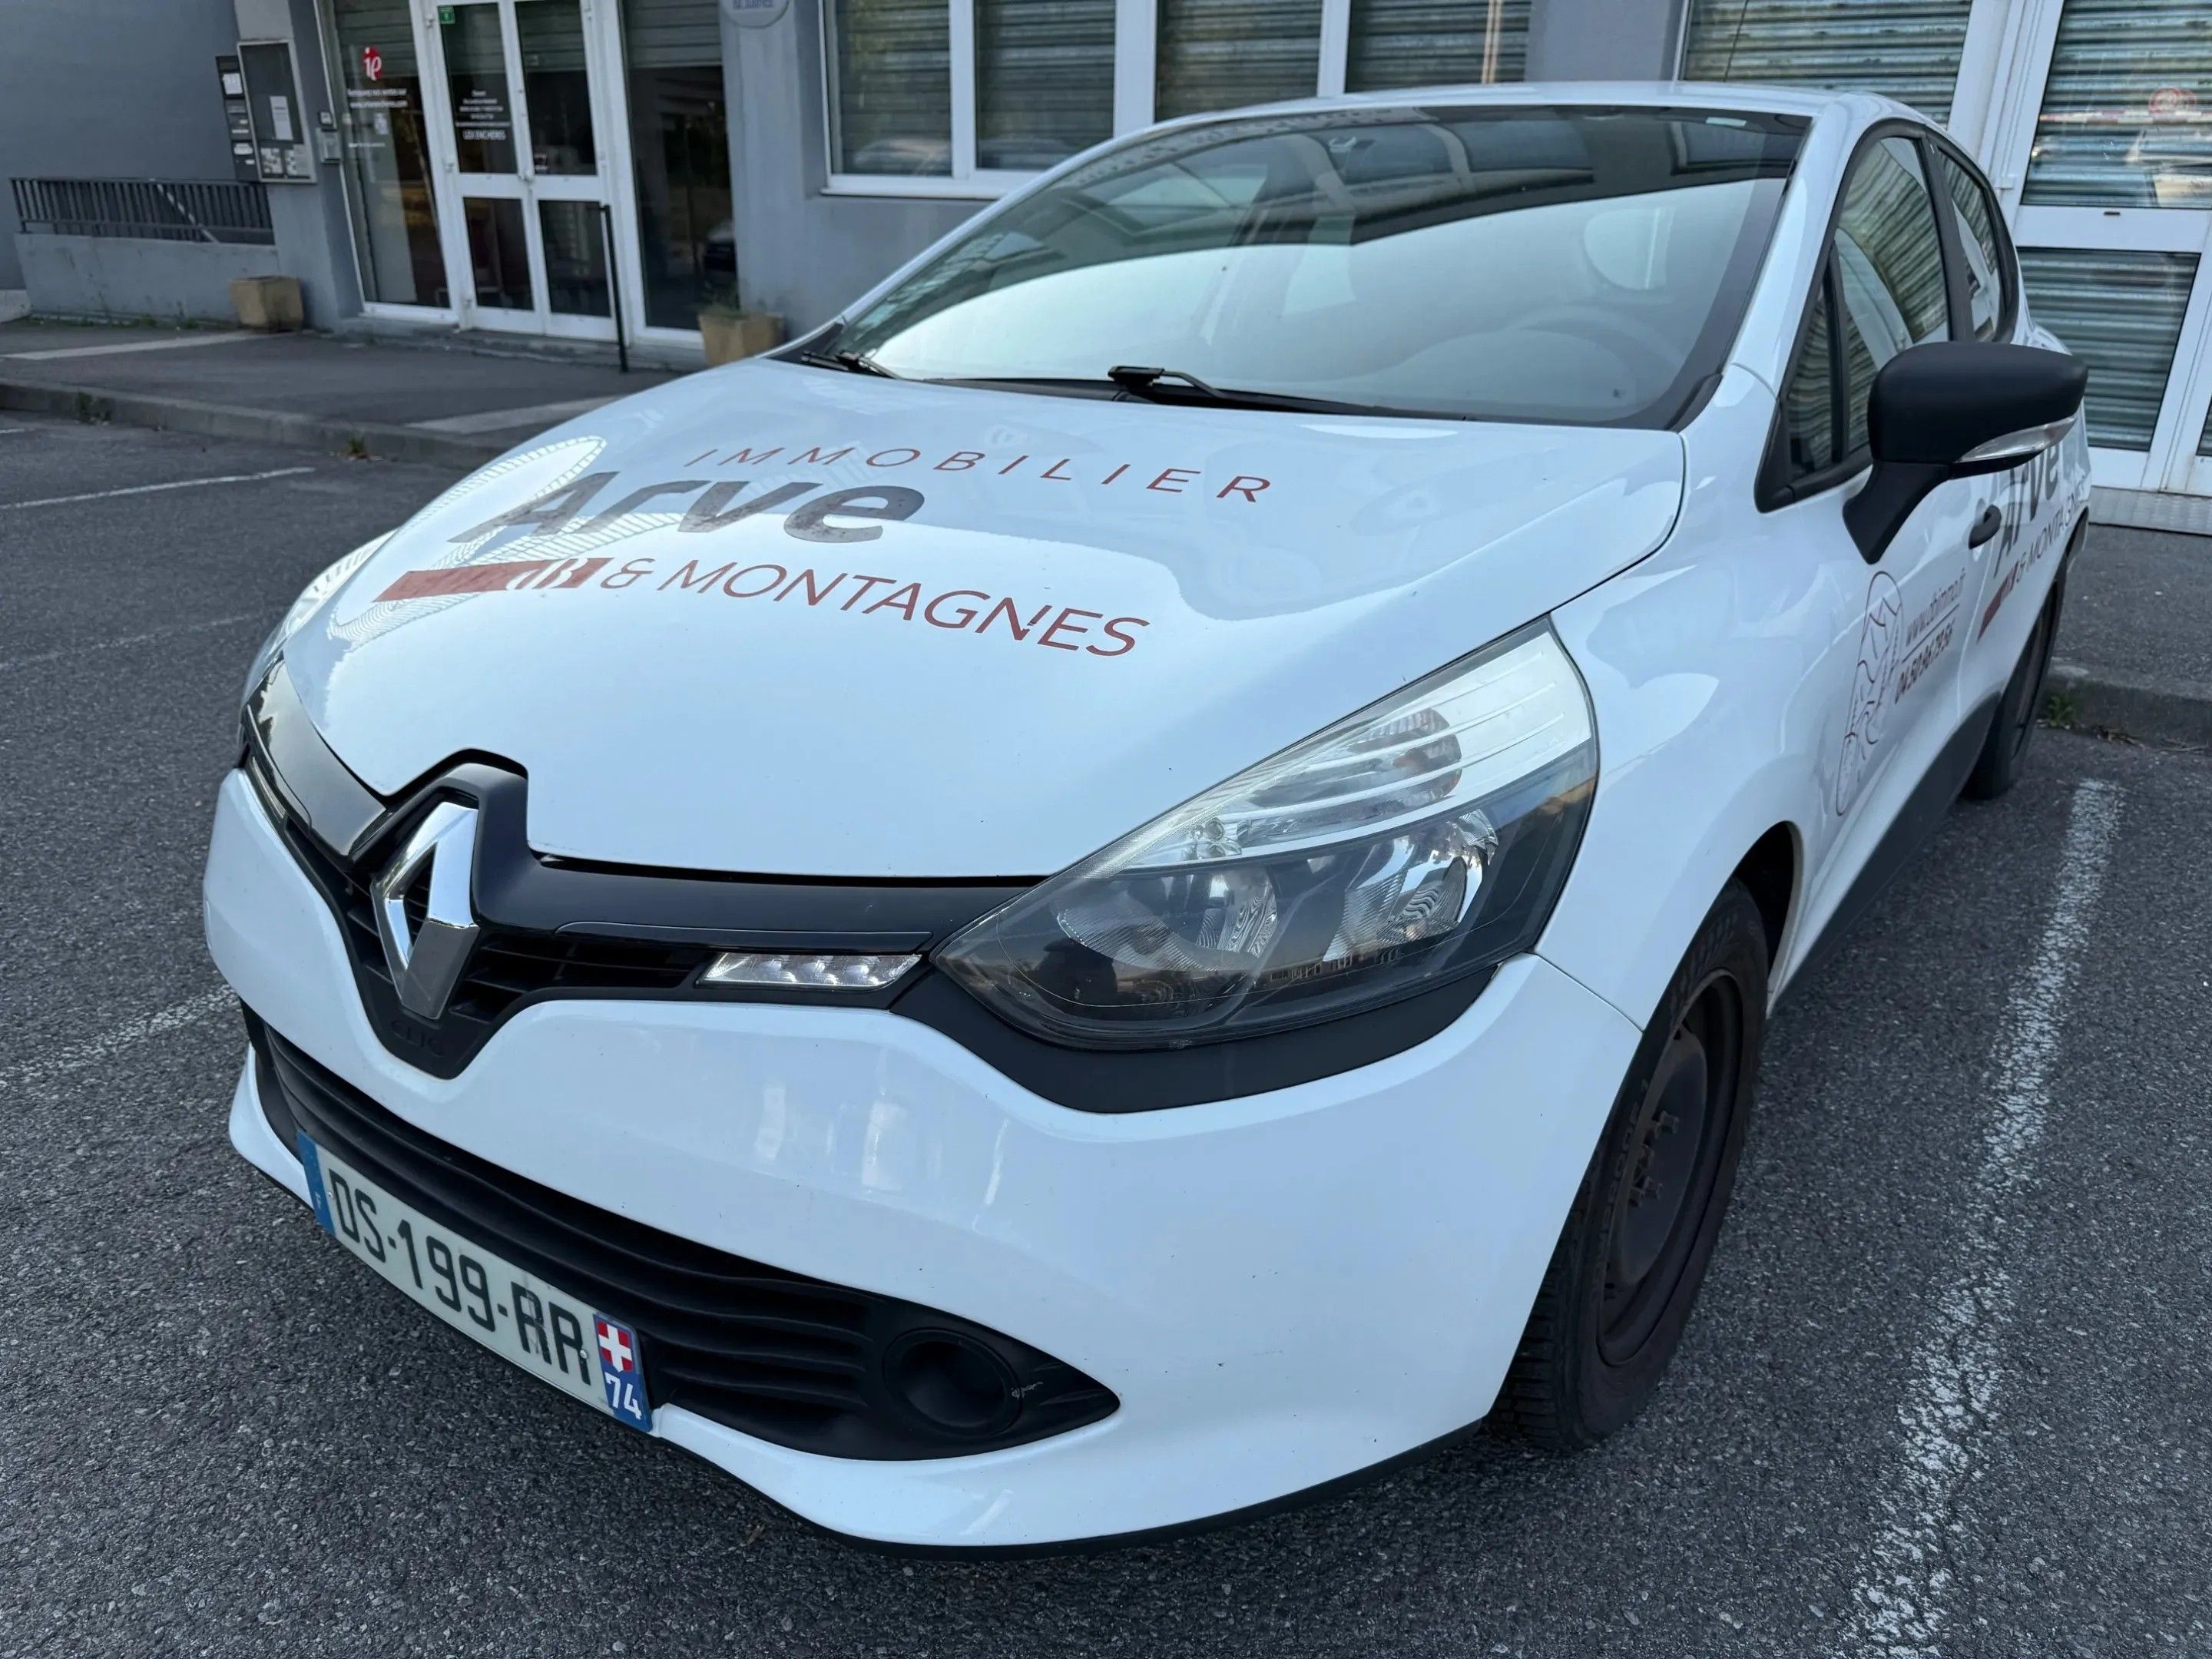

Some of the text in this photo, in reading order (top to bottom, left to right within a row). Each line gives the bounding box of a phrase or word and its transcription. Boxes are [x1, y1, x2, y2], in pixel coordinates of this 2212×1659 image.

[446, 471, 926, 544] Arve
[684, 447, 1271, 503] IMMOBILIER
[600, 558, 1151, 657] & MONTAGNES
[329, 1168, 591, 1387] DS-199-RR
[604, 1372, 643, 1421] 74
